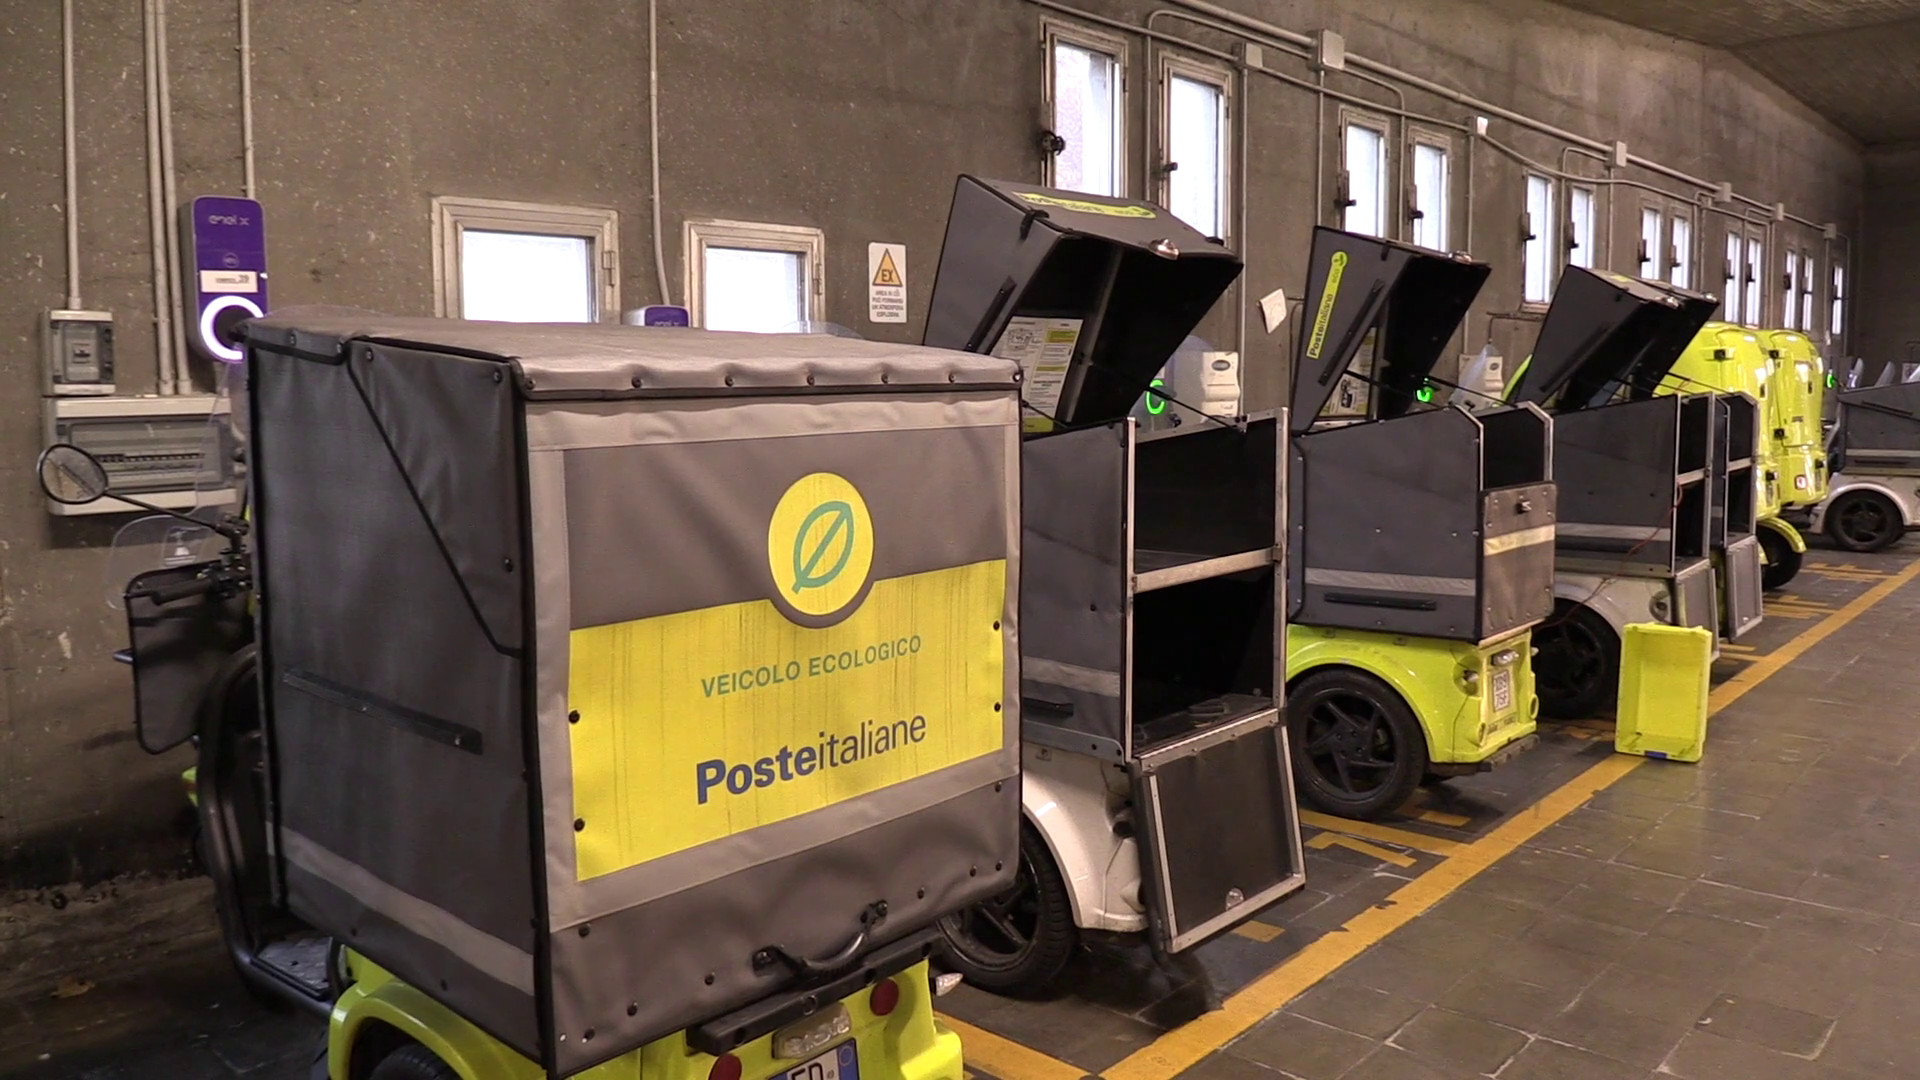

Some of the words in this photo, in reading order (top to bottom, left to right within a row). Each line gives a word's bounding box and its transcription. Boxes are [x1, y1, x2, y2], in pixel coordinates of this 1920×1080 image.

[208, 214, 237, 226] enel
[881, 268, 894, 282] EX
[701, 661, 801, 698] VEICOLO
[808, 634, 922, 678] ECOLOGICO
[696, 714, 927, 806] Posteitaliane
